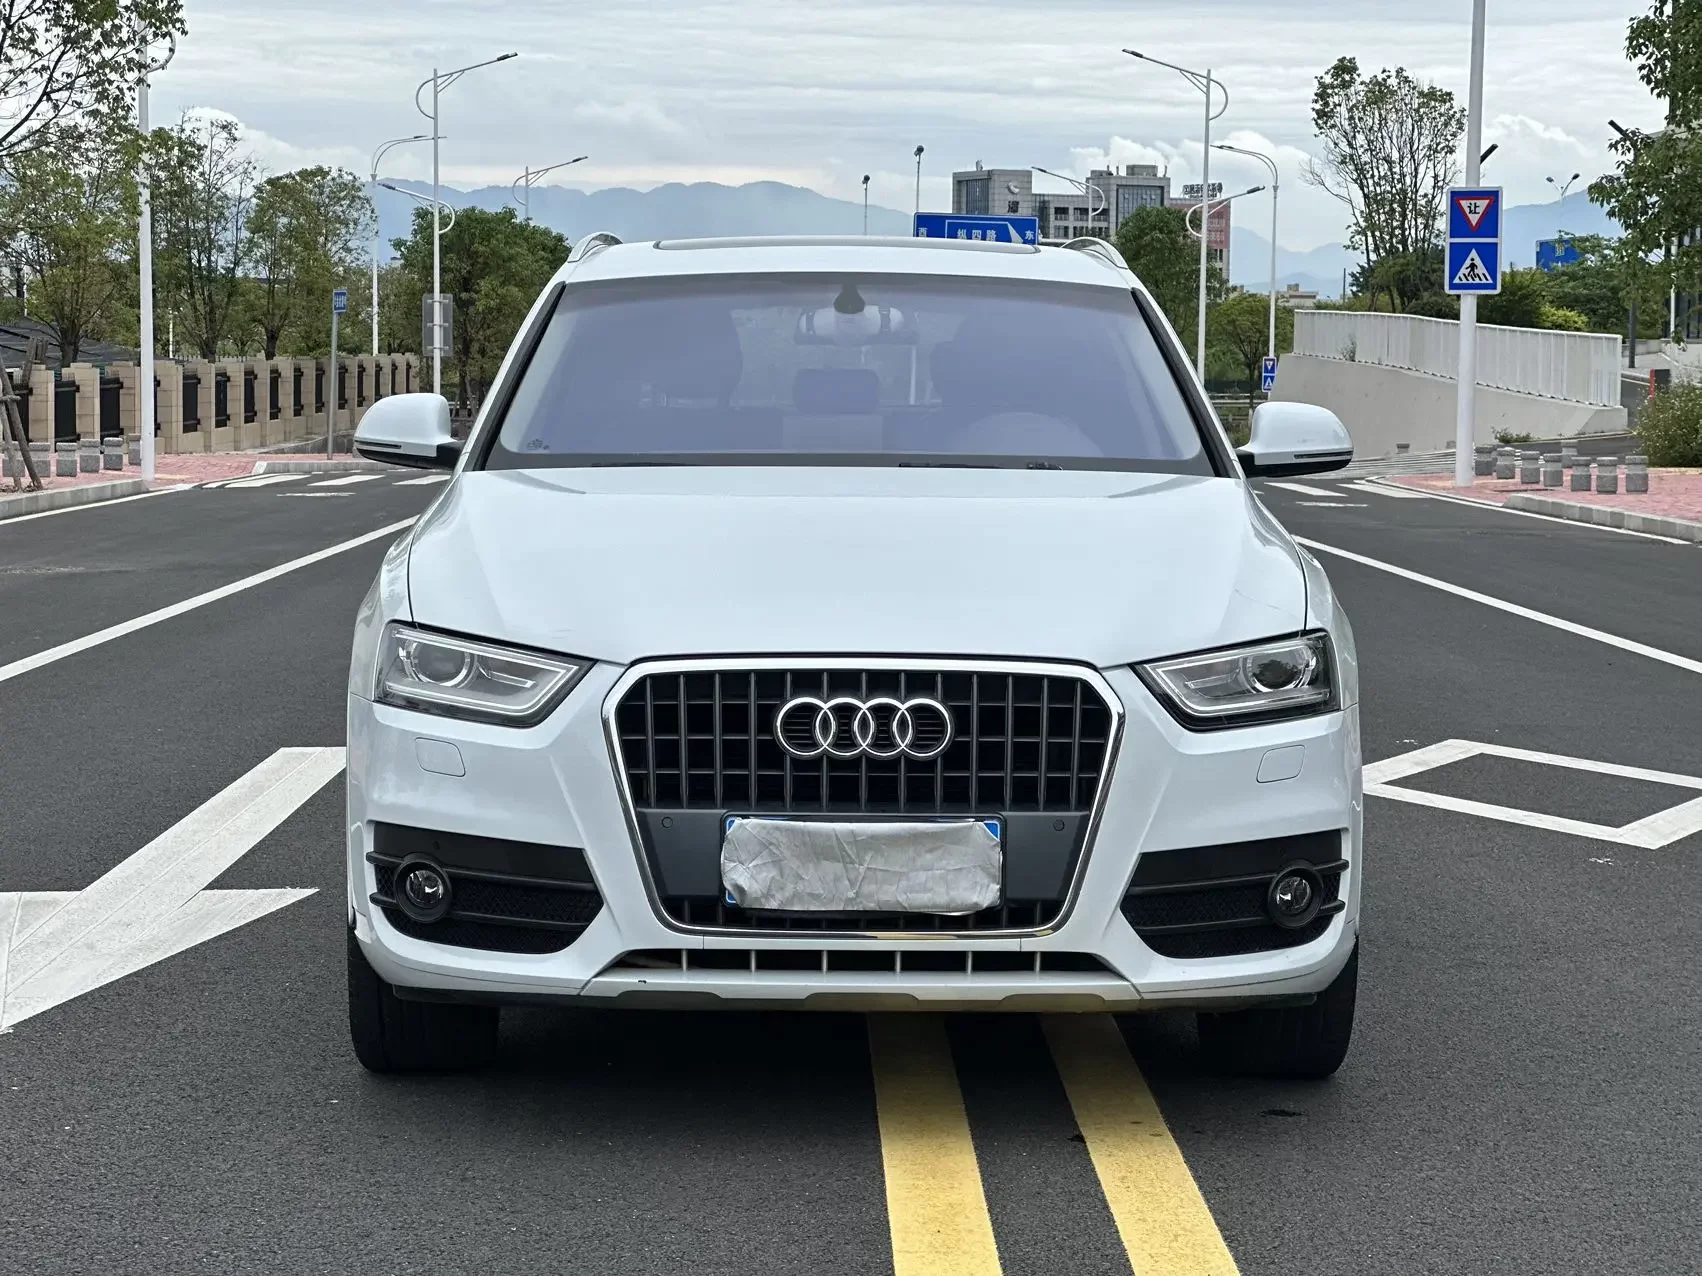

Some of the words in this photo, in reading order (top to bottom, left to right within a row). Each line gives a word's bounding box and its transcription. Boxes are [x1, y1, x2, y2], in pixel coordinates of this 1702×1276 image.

[1467, 202, 1480, 214] 让
[918, 228, 927, 237] 西
[957, 229, 996, 241] 纵四路
[1025, 230, 1035, 240] 东
